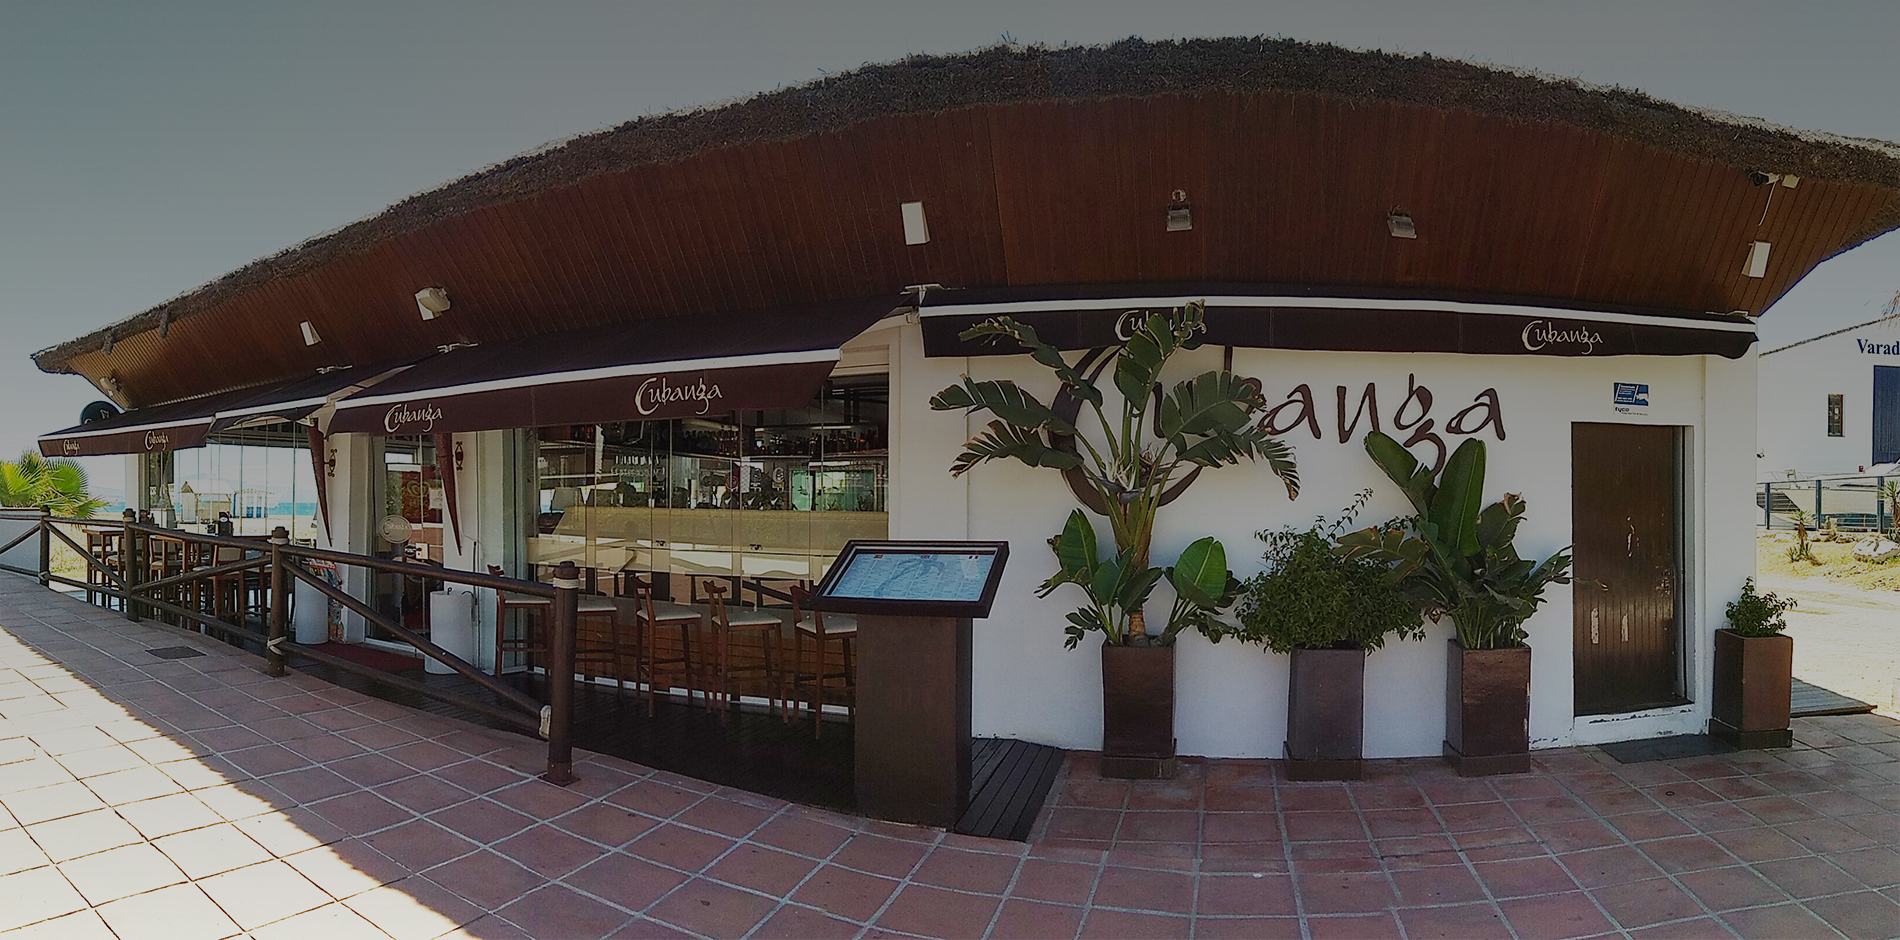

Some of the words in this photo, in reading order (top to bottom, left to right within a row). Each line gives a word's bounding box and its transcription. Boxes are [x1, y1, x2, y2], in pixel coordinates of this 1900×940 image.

[1521, 320, 1604, 355] Cubanga
[1856, 338, 1900, 356] Varad
[635, 376, 723, 415] Cubanga
[384, 403, 443, 433] Cubanga
